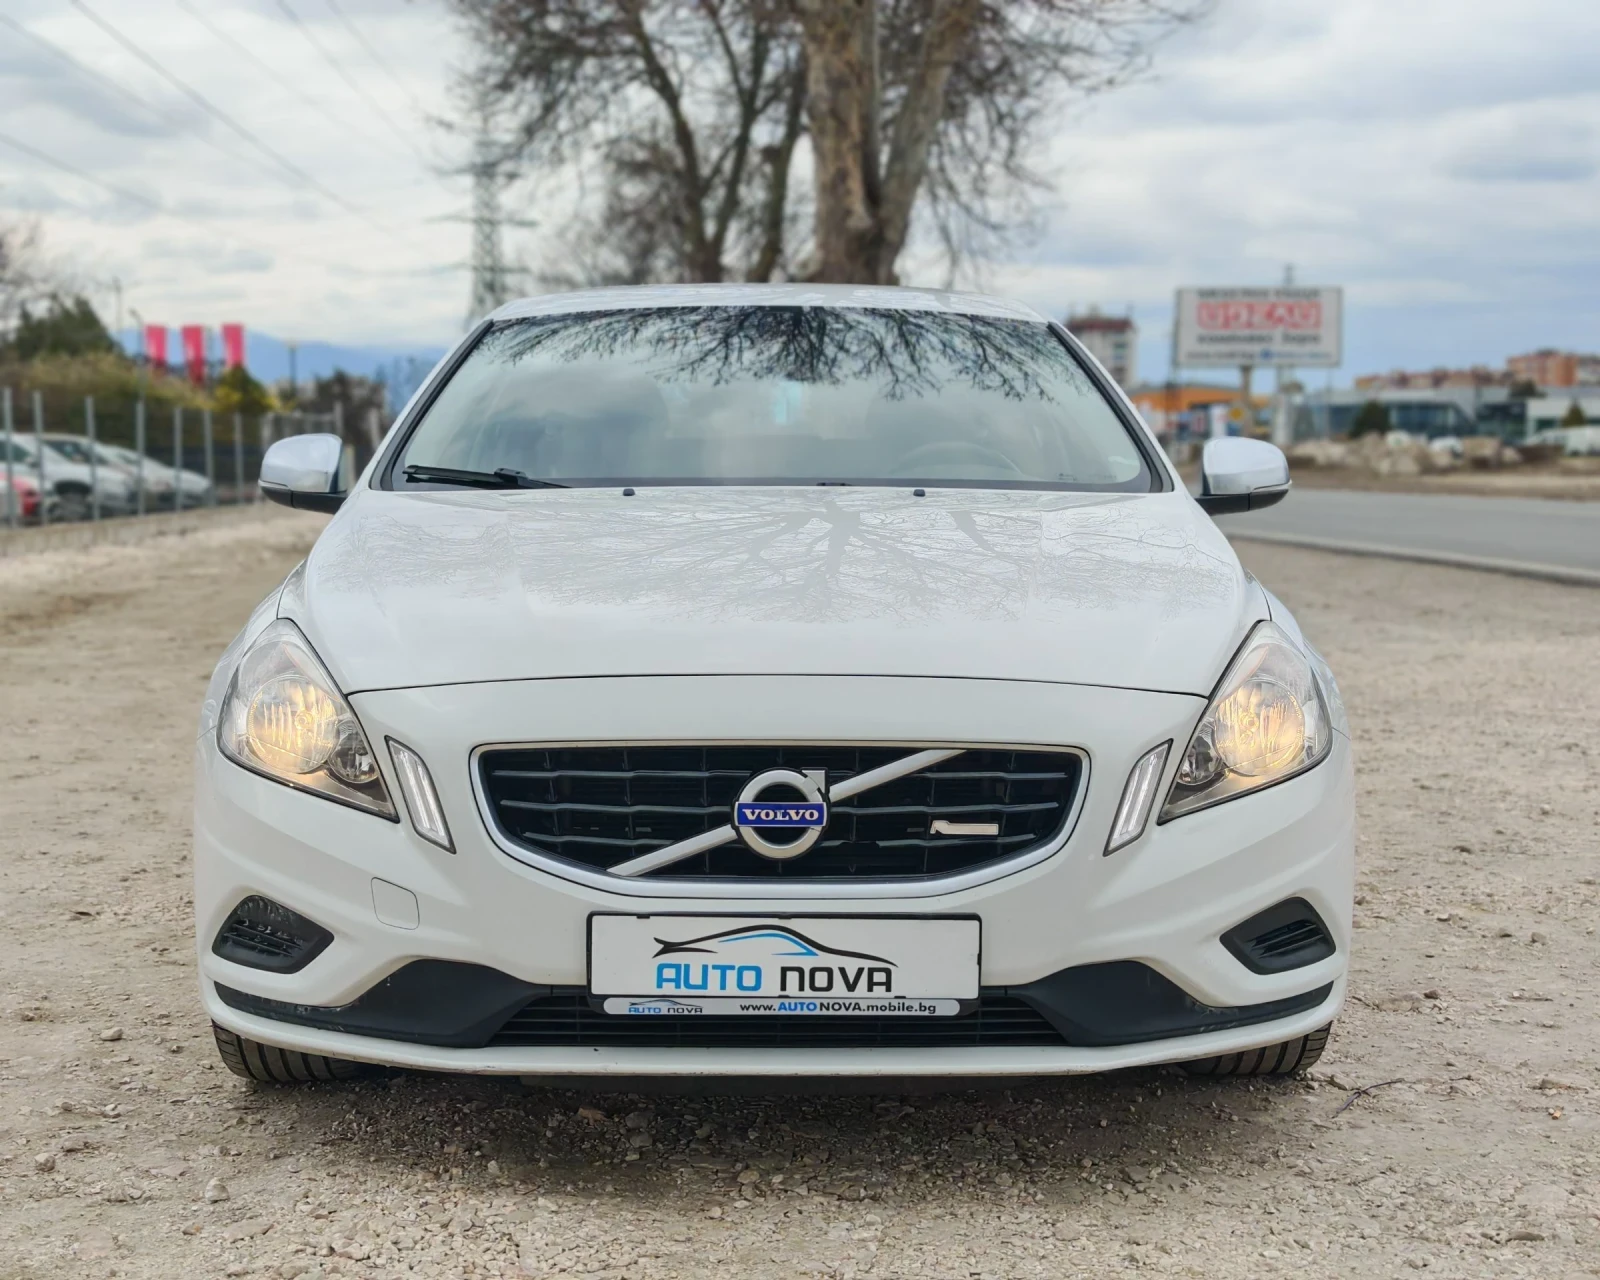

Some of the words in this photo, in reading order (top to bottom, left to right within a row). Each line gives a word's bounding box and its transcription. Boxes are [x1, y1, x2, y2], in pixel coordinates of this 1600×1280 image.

[742, 808, 819, 821] VOLVO
[656, 963, 762, 992] AUTO
[779, 966, 893, 993] NOVA
[628, 1006, 662, 1014] AUTO
[667, 1006, 703, 1014] NOVA
